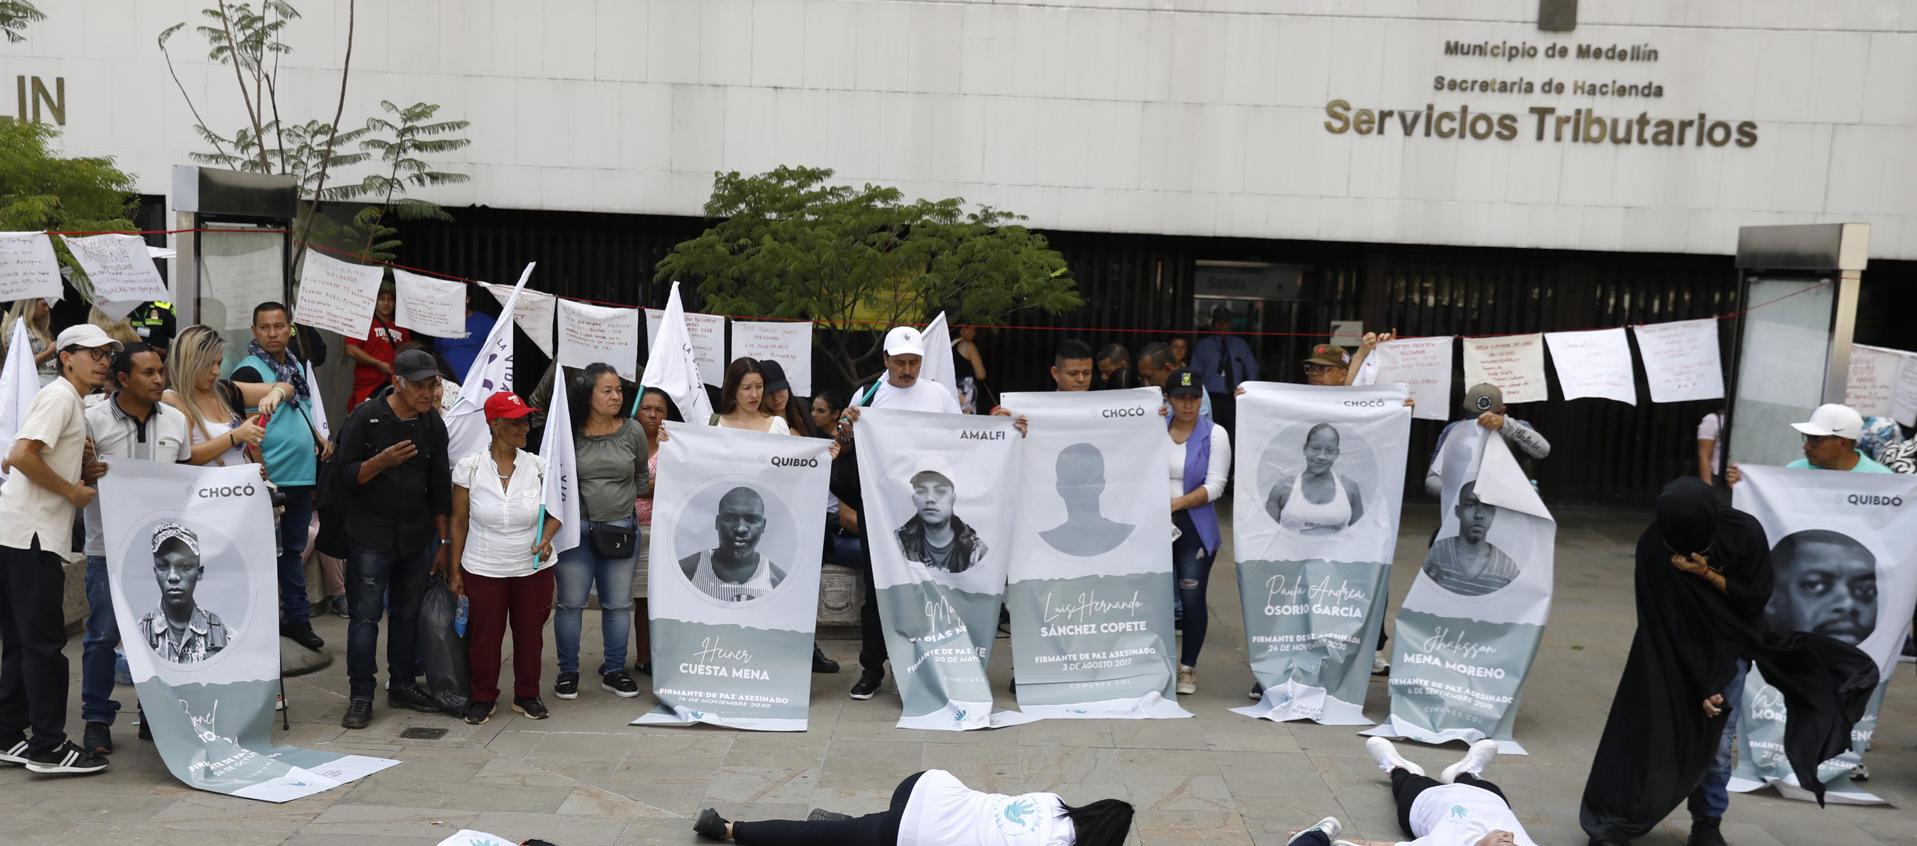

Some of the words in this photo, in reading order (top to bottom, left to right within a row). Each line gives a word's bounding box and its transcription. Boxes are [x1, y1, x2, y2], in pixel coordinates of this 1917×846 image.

[1444, 41, 1537, 63] Municipio
[1545, 43, 1568, 60] de
[1576, 43, 1659, 62] Medellín
[1433, 75, 1535, 95] Secretaria
[1542, 77, 1565, 95] de
[1573, 78, 1664, 98] Hacienda
[0, 74, 66, 127] IN
[1323, 99, 1519, 140] Servicios
[1528, 106, 1759, 148] Tributarios
[496, 338, 507, 351] LA
[1344, 398, 1385, 408] CHOCÓ
[1102, 405, 1145, 418] CHOCÓ
[960, 430, 1006, 441] AMALFI
[771, 456, 819, 468] QUIBDÓ
[198, 483, 256, 499] CHOCÓ
[1847, 493, 1904, 508] QUIBDÓ
[1307, 575, 1367, 607] Andrea
[1264, 604, 1309, 617] OSORIO
[1311, 603, 1363, 619] GARCÍA
[1040, 623, 1098, 638] SÁNCHEZ
[1100, 620, 1148, 635] COPETE
[1252, 634, 1294, 643] FIRMANTE
[692, 635, 753, 667] Heiner
[1034, 653, 1078, 664] FIRMANTE
[1079, 651, 1090, 661] DE
[1091, 650, 1107, 660] PAZ
[1108, 647, 1156, 659] ASESINADO
[679, 662, 728, 677] CUESTA
[731, 668, 770, 681] MENA
[1069, 662, 1079, 670] DE
[1081, 660, 1113, 669] AGOSTO
[1113, 658, 1132, 668] 2017
[1403, 653, 1442, 667] MENA
[1444, 663, 1506, 680] MORENO
[659, 687, 704, 698] FIRMANTE
[705, 690, 718, 699] DE
[719, 691, 737, 701] PAZ
[739, 693, 789, 704] ASESINADO
[1413, 687, 1423, 695] DE
[1431, 681, 1443, 690] DE
[1444, 683, 1462, 694] PAZ
